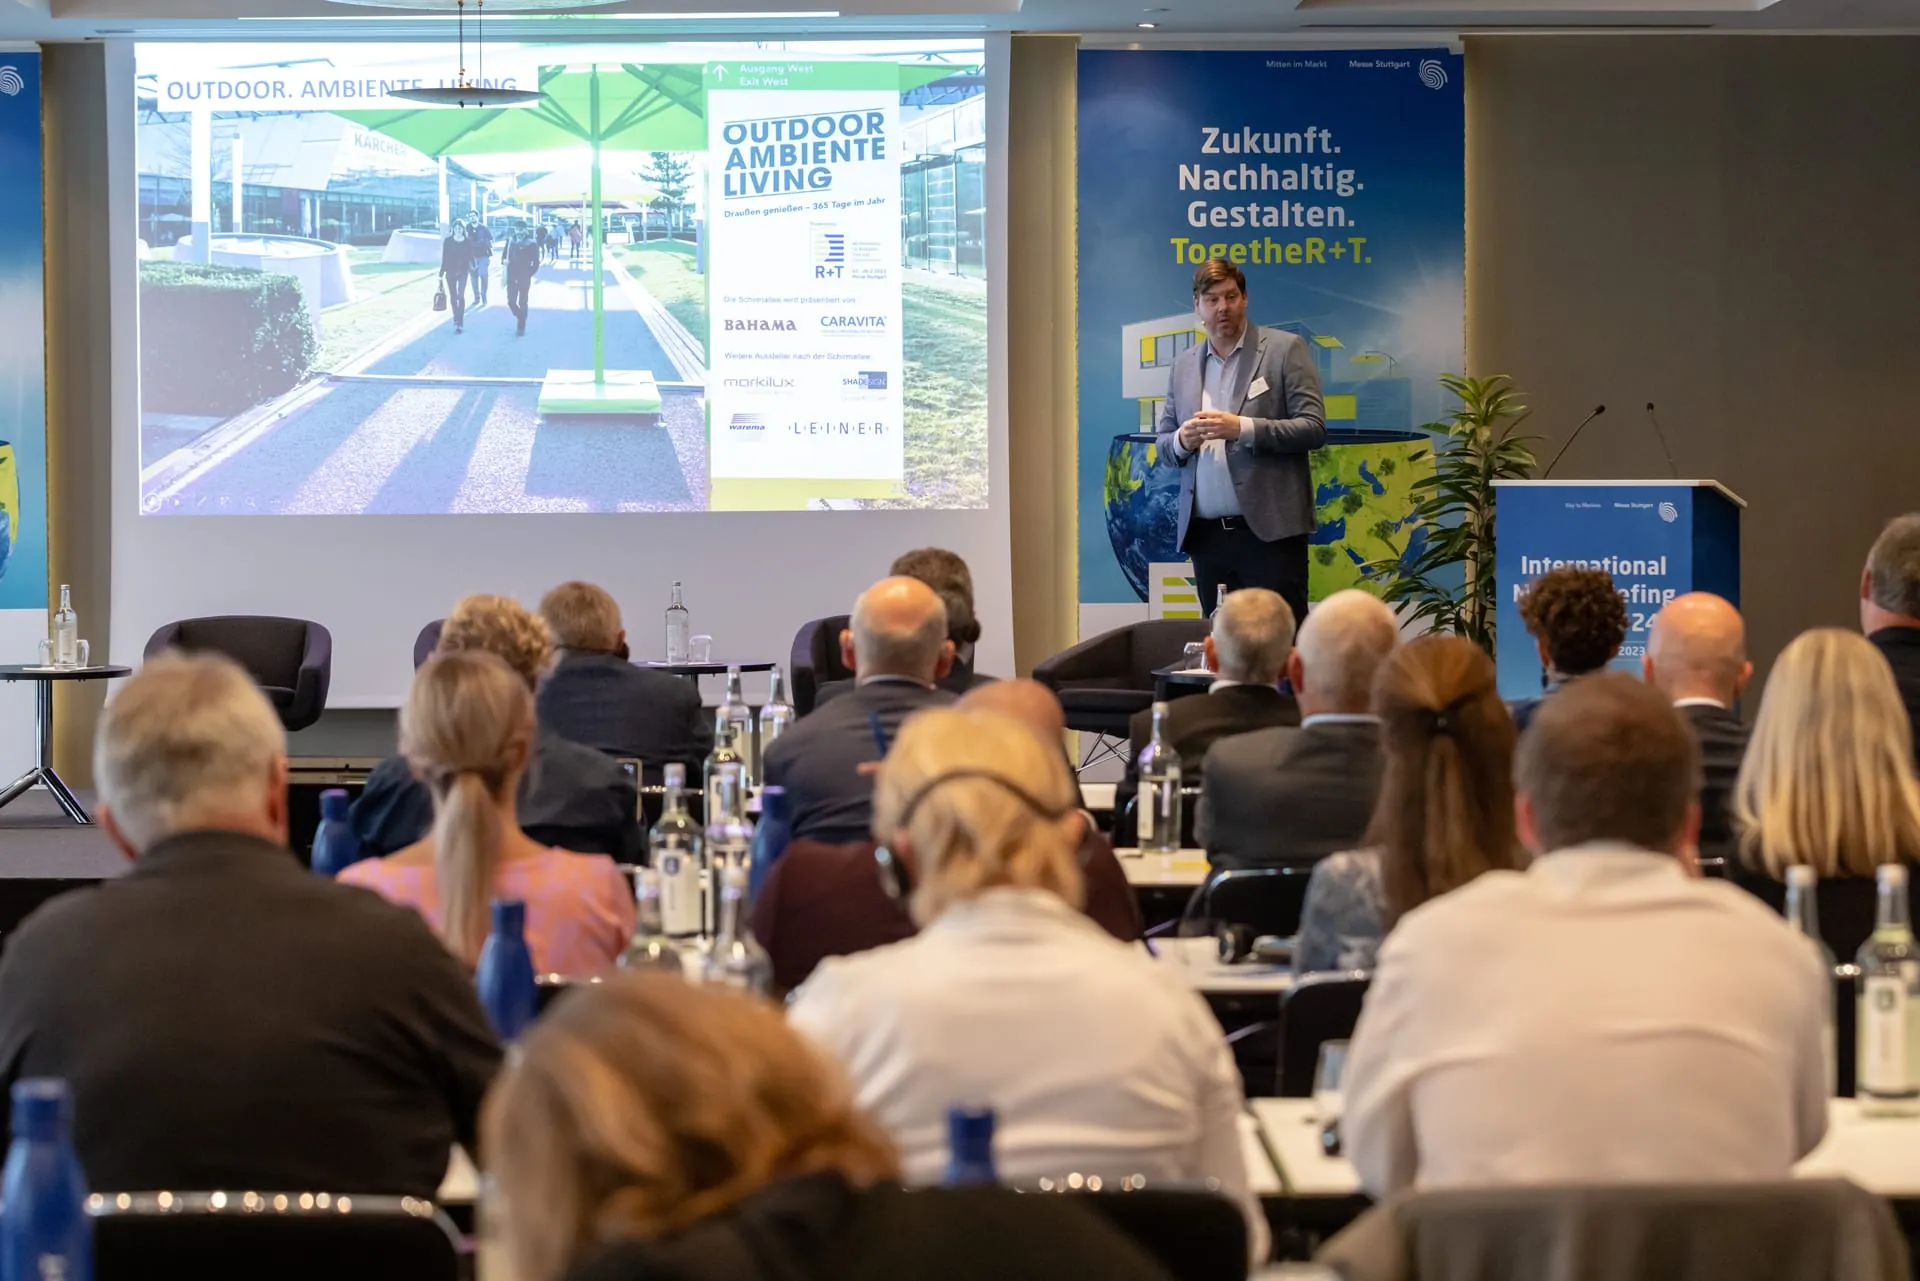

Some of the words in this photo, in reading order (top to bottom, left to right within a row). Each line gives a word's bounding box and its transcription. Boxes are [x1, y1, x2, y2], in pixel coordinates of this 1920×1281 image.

[740, 64, 784, 75] Ausgang
[787, 63, 814, 74] West
[1266, 60, 1291, 68] Mitten
[1293, 60, 1303, 68] im
[1304, 60, 1328, 68] Markt
[1349, 60, 1374, 68] Messe
[1375, 60, 1410, 70] Stuttgart
[167, 79, 292, 101] OUTDOOR.
[740, 77, 759, 87] Exit
[762, 77, 788, 87] West
[723, 112, 885, 145] OUTDOOR
[1201, 126, 1342, 154] Zukunft.
[725, 136, 885, 171] AMBIENTE
[724, 167, 832, 196] LIVING
[1179, 163, 1364, 197] Nachhaltig.
[724, 208, 761, 218] Draußen
[763, 204, 803, 217] genießen
[812, 202, 829, 210] 365
[832, 200, 851, 210] Tage
[866, 196, 885, 205] Jahr
[1188, 200, 1355, 227] Gestalten.
[1171, 236, 1372, 264] TogetheR+T.
[815, 265, 844, 279] R+T
[724, 376, 794, 388] markilux
